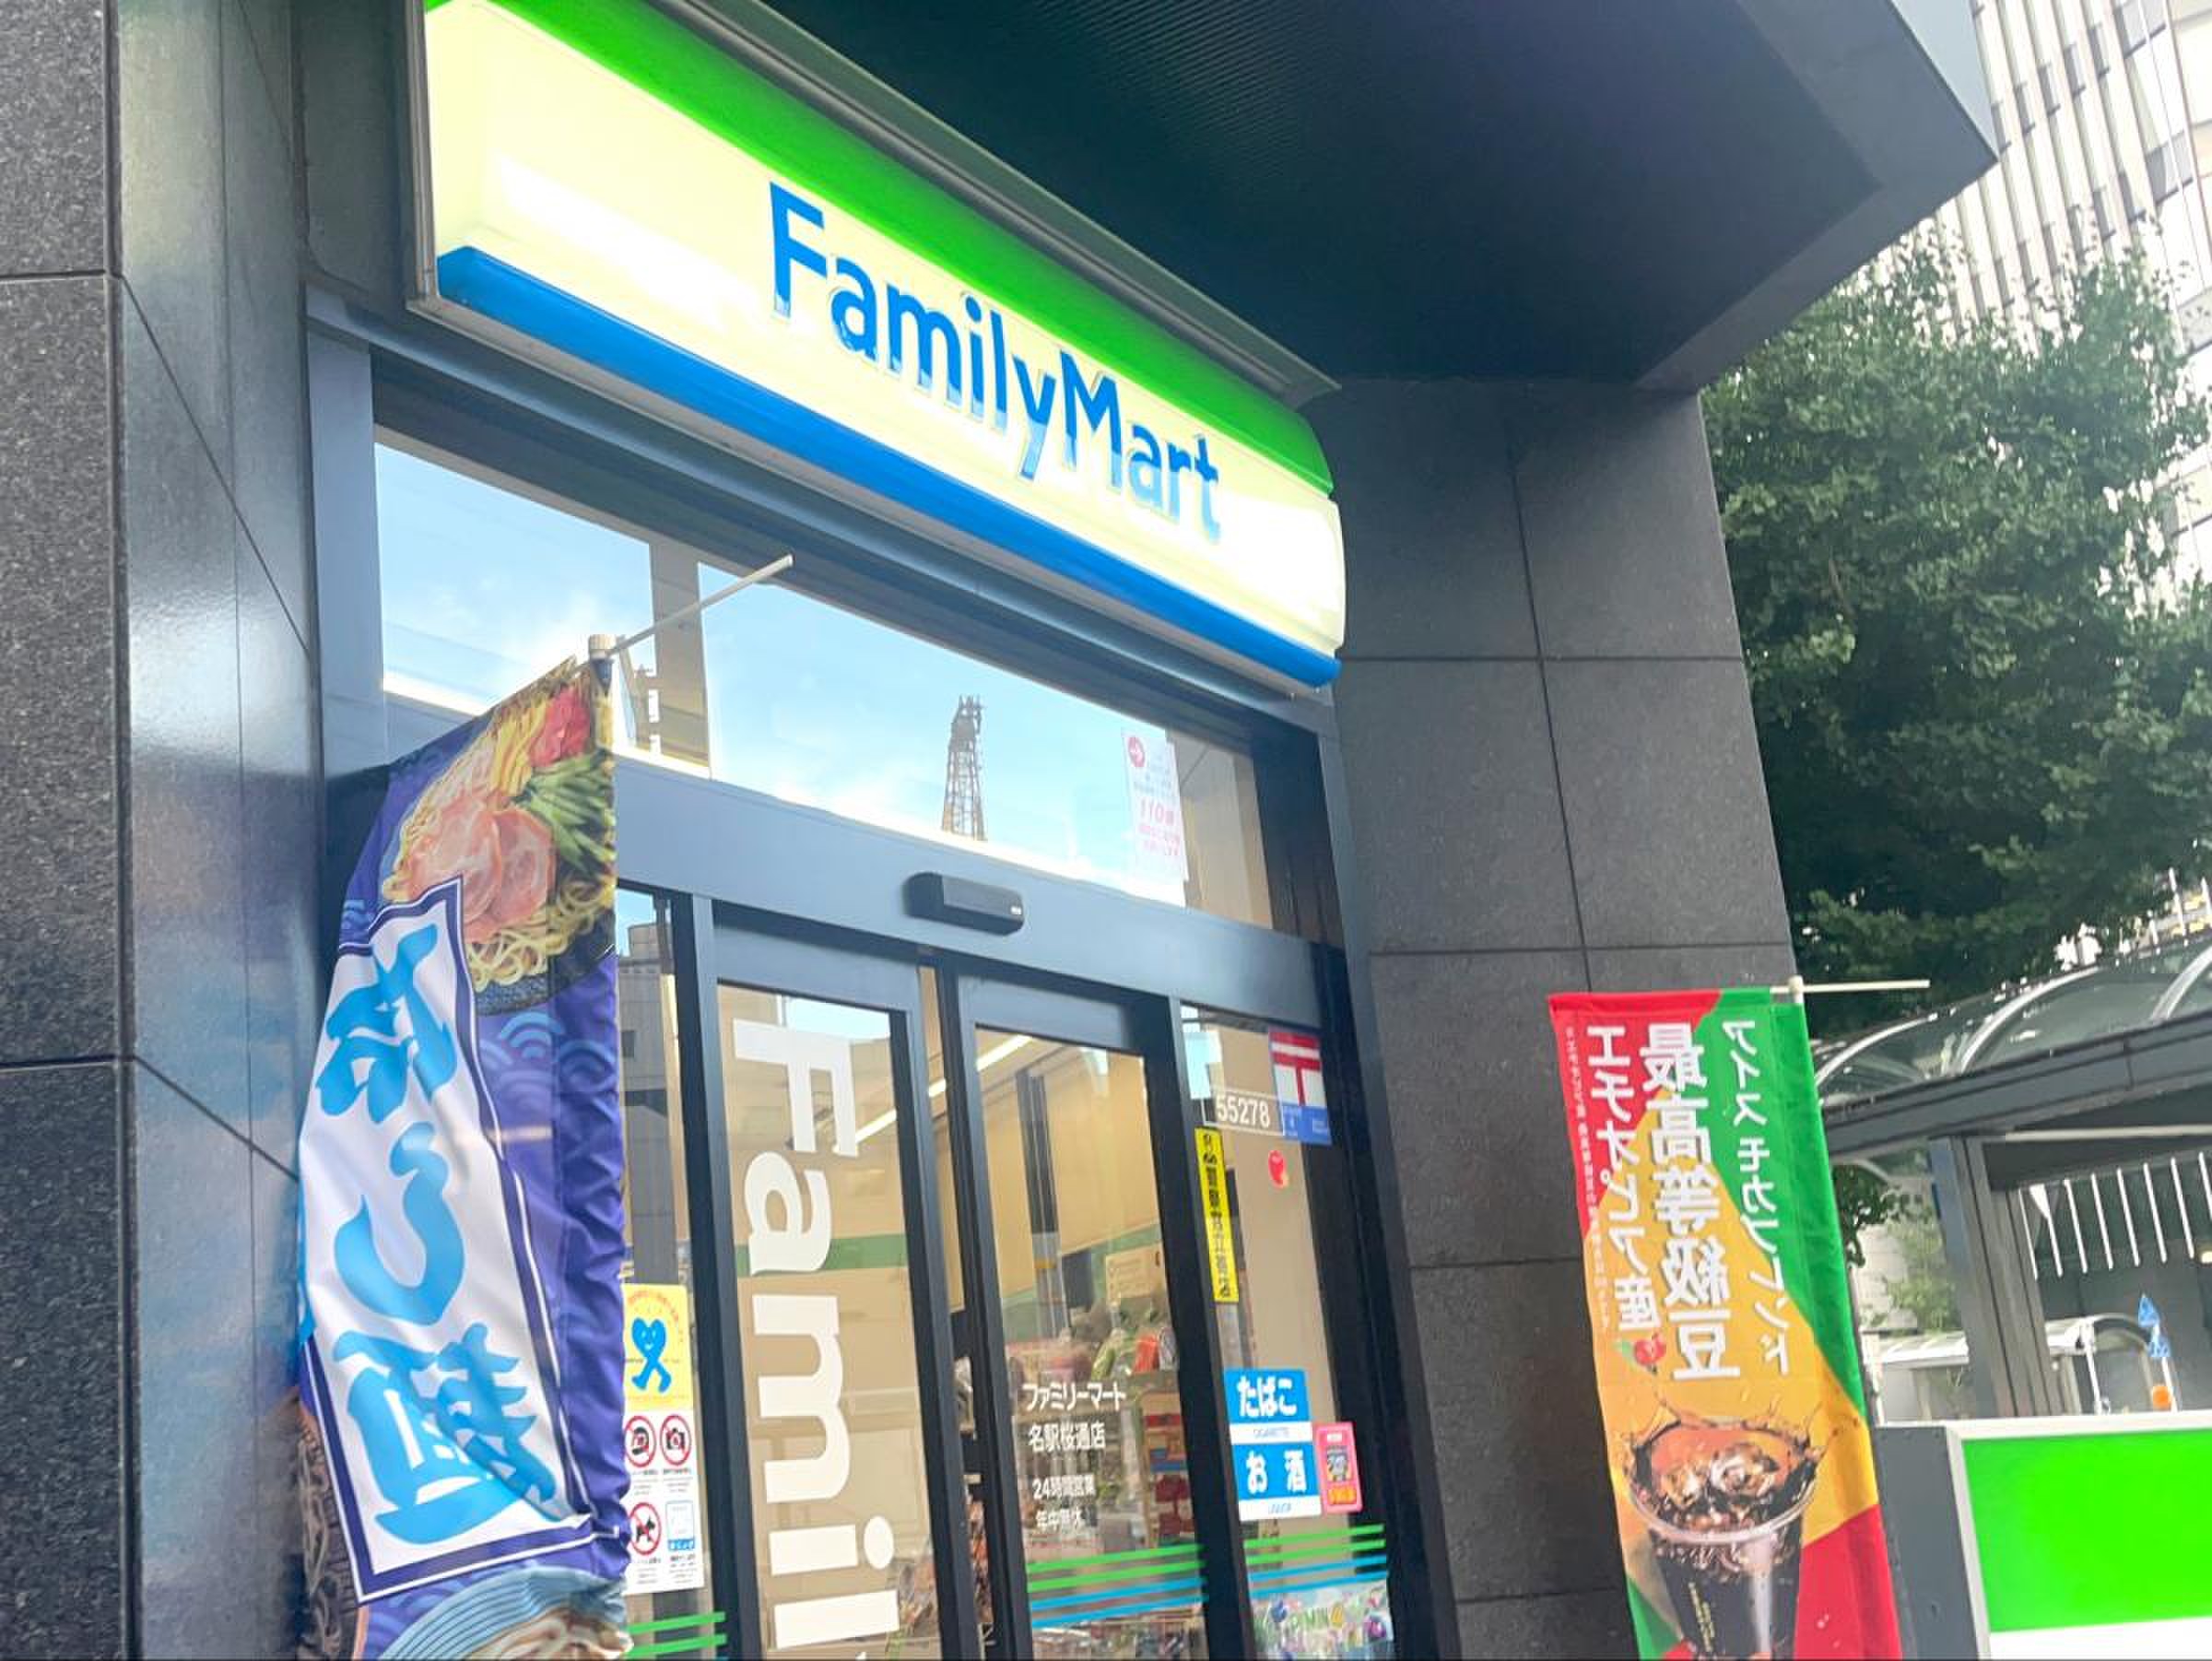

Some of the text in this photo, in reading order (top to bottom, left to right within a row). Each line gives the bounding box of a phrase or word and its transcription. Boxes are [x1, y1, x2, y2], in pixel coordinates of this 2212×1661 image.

[770, 181, 1221, 546] FamilyMart
[1217, 1094, 1270, 1128] 55278
[734, 1018, 901, 1659] Famil
[1022, 1381, 1126, 1412] ファミリーマート
[1236, 1375, 1298, 1418] たばこ
[1029, 1420, 1106, 1454] 名駅桜通店
